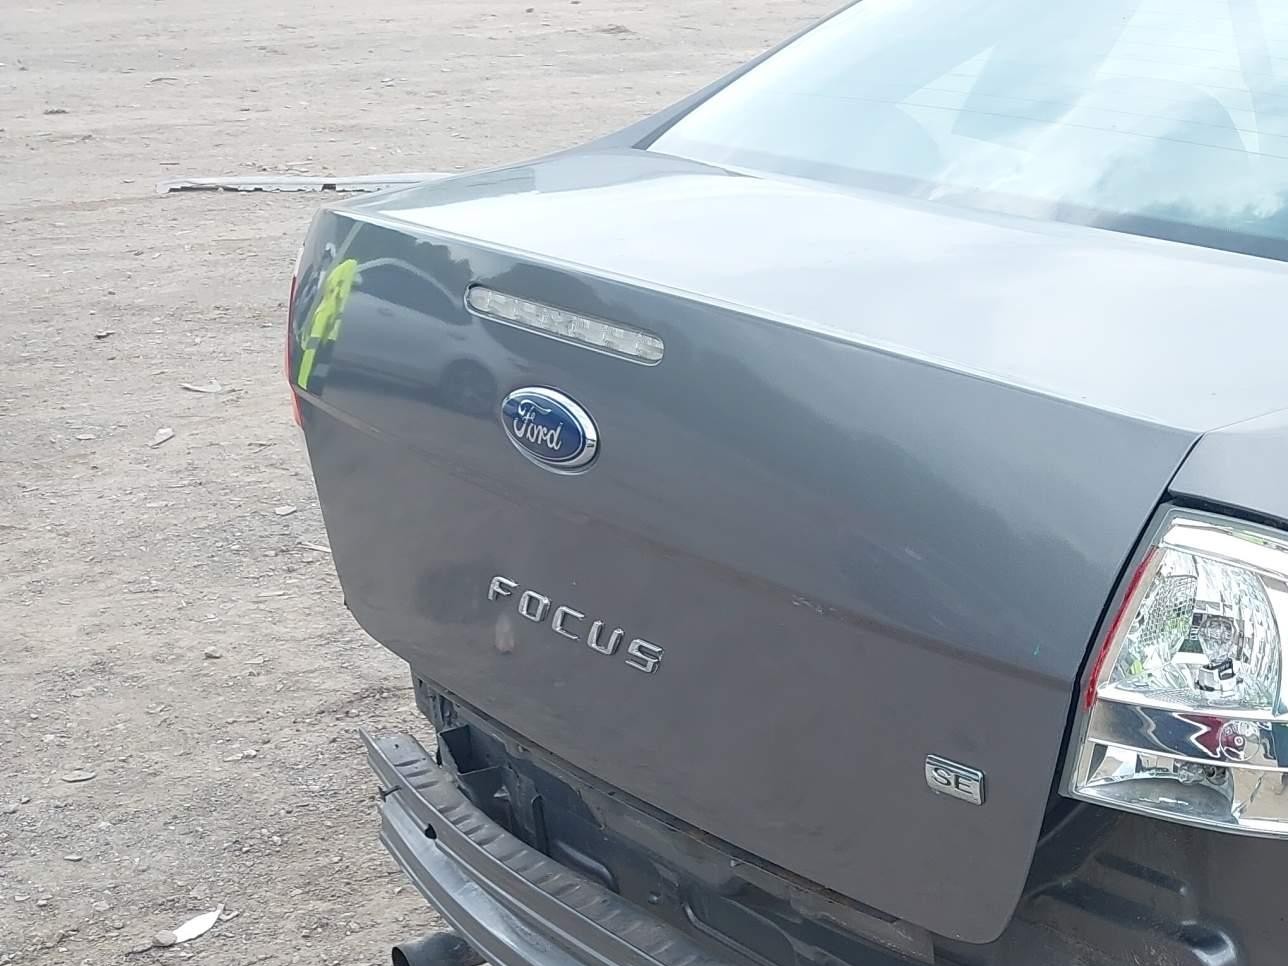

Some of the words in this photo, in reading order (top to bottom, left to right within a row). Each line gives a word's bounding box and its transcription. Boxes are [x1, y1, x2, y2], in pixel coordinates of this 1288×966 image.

[513, 398, 563, 450] Ford
[487, 575, 665, 675] FOCUS
[932, 766, 974, 795] SE
